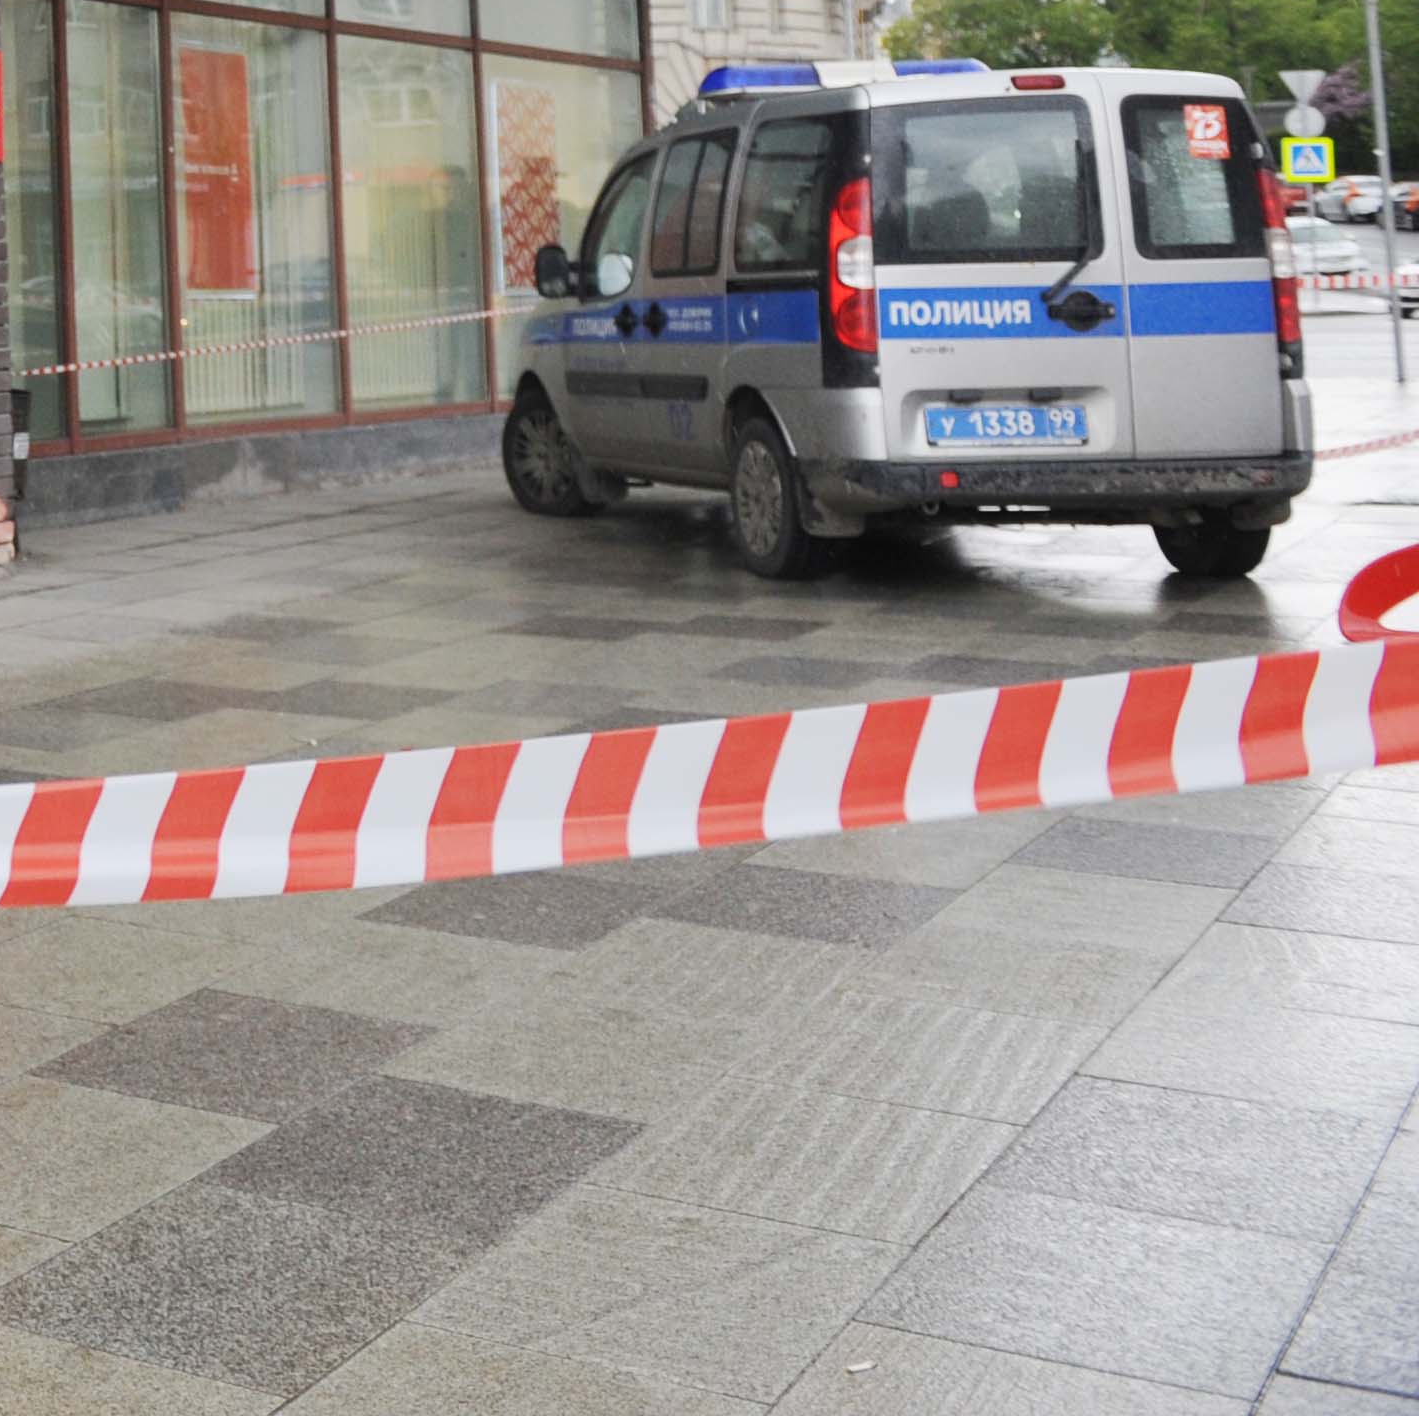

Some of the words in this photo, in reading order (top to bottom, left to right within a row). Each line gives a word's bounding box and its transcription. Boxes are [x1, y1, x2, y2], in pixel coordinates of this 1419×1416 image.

[889, 299, 1033, 329] ПОЛИЦИЯ
[969, 410, 1036, 437] 1338
[1048, 409, 1076, 430] 99
